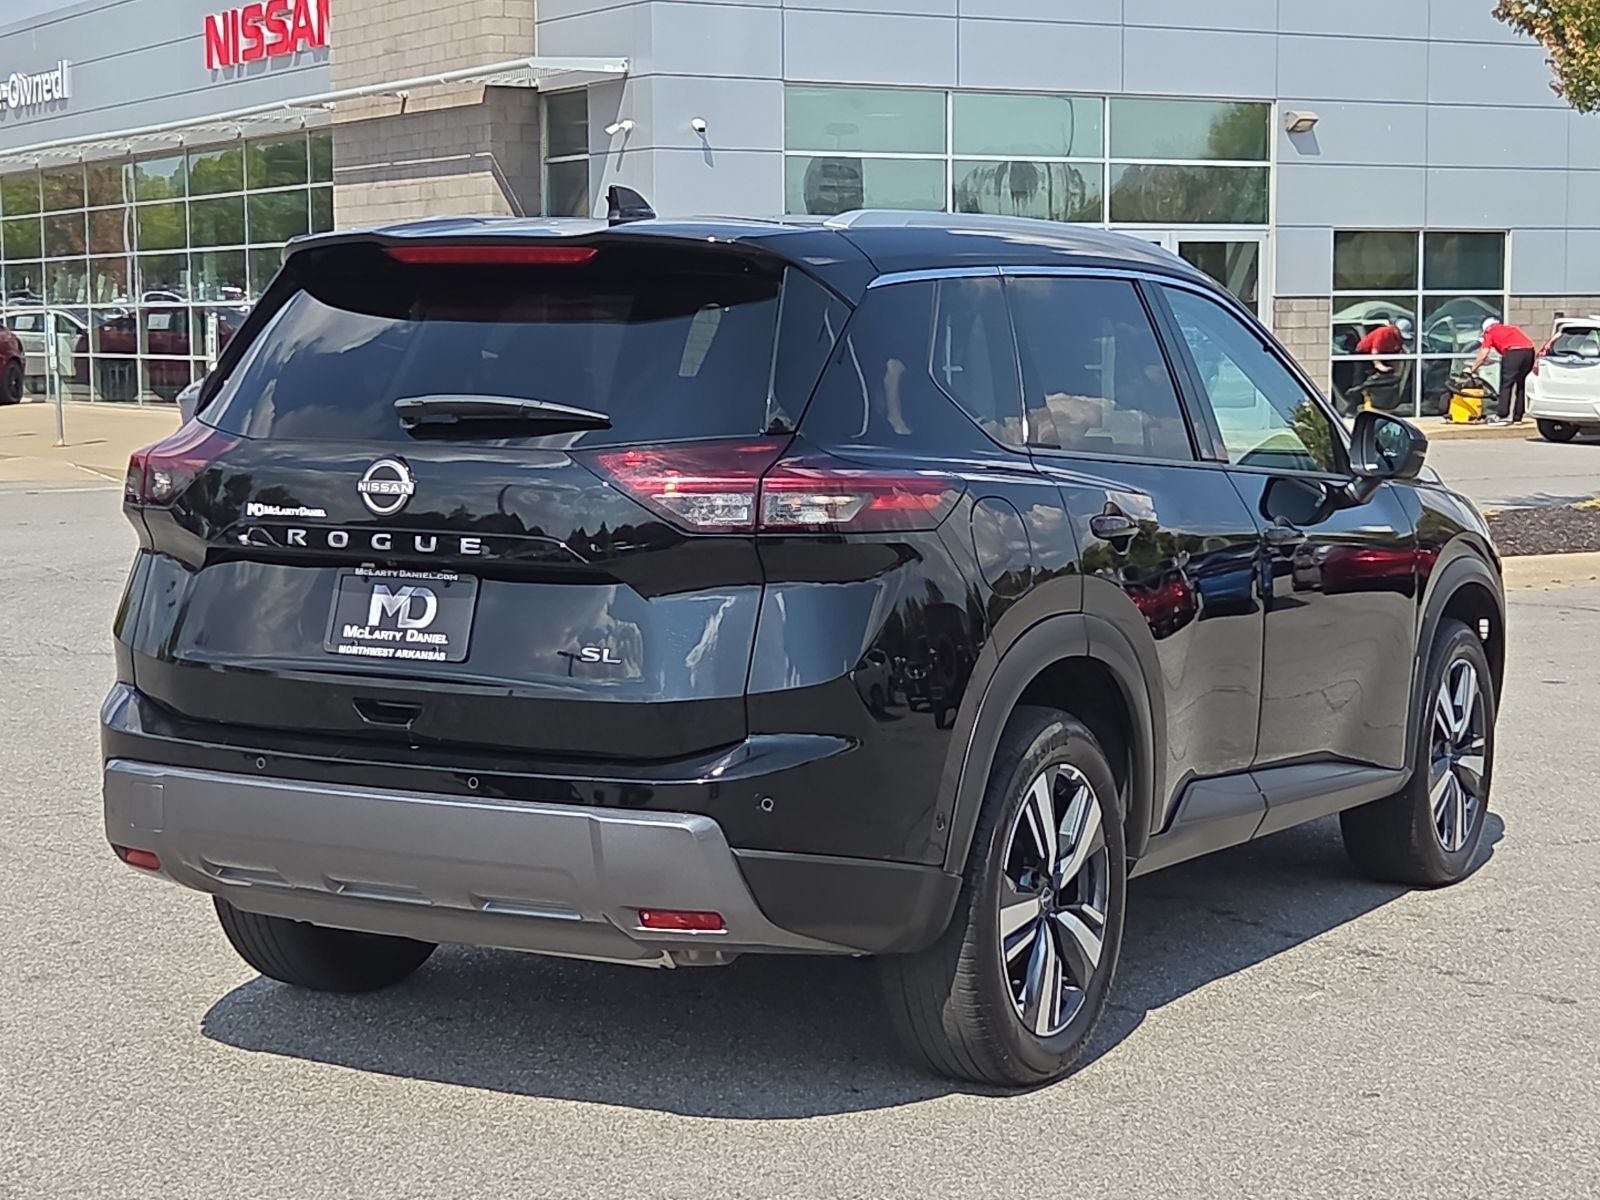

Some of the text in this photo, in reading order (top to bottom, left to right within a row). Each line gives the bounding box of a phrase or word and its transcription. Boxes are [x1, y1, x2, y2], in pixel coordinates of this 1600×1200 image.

[357, 481, 415, 494] NISSAN
[287, 528, 482, 555] ROGUE
[368, 584, 437, 628] MD
[338, 645, 447, 661] NORTHWEST ARKANSAS
[581, 647, 622, 664] SL
